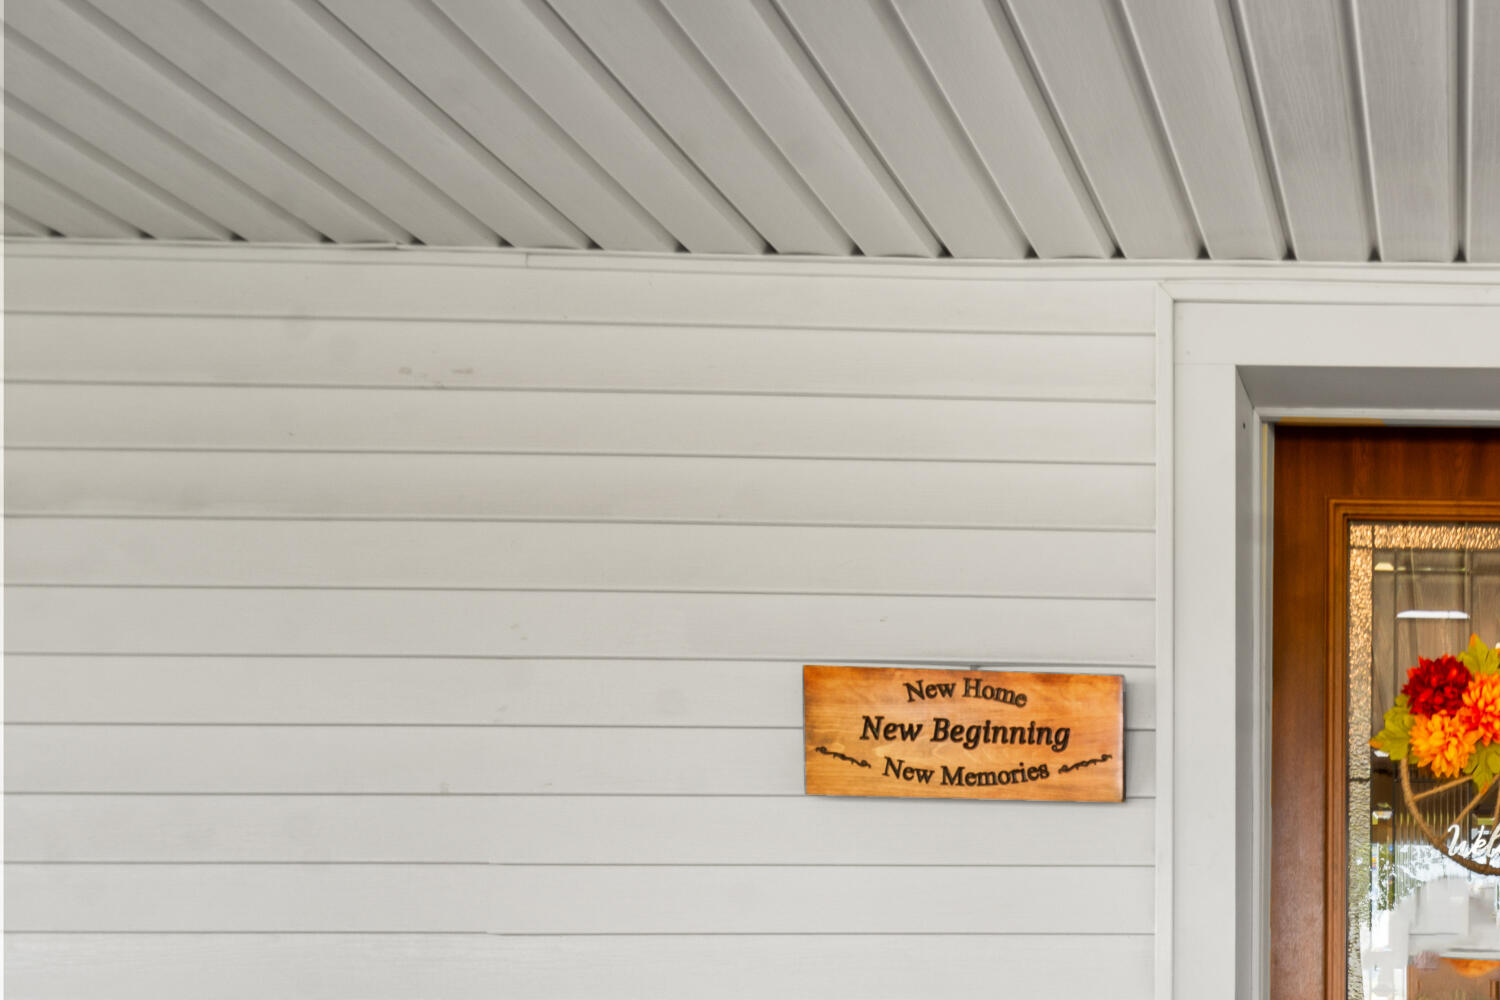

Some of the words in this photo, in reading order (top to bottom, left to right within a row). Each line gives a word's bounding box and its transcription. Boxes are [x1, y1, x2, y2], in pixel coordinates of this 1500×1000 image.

[903, 679, 955, 703] New
[962, 677, 1028, 708] Home
[860, 715, 922, 741] New
[930, 718, 1071, 751] Beginning
[882, 756, 934, 784] New
[940, 762, 1049, 787] Memories
